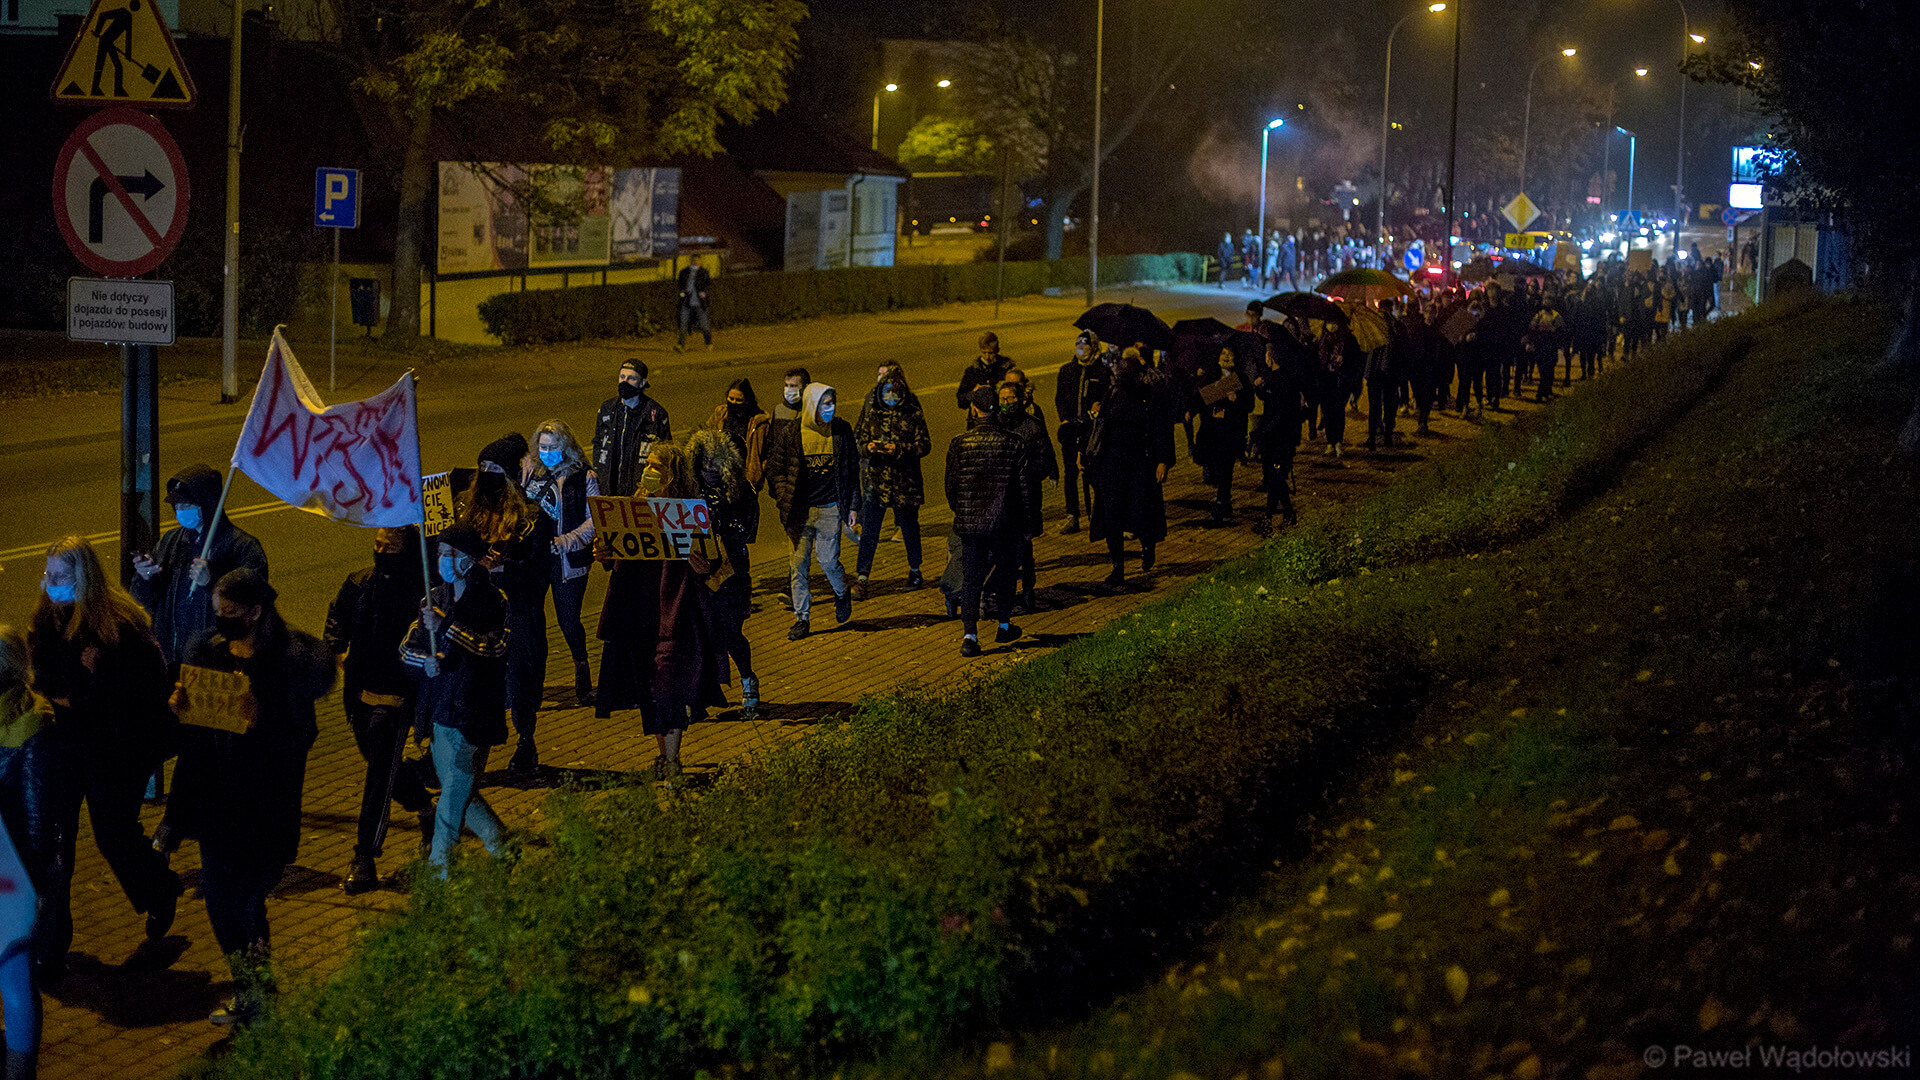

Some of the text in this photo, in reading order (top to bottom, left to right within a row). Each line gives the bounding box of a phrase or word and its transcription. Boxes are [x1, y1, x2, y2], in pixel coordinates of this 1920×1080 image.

[325, 174, 348, 209] P
[91, 291, 149, 304] Nie dotyczy
[74, 304, 167, 320] dojazdu do posesji
[79, 318, 125, 330] pojazdów
[128, 320, 168, 333] budowy
[596, 500, 711, 529] PIEKŁO
[602, 531, 711, 559] KOBIET
